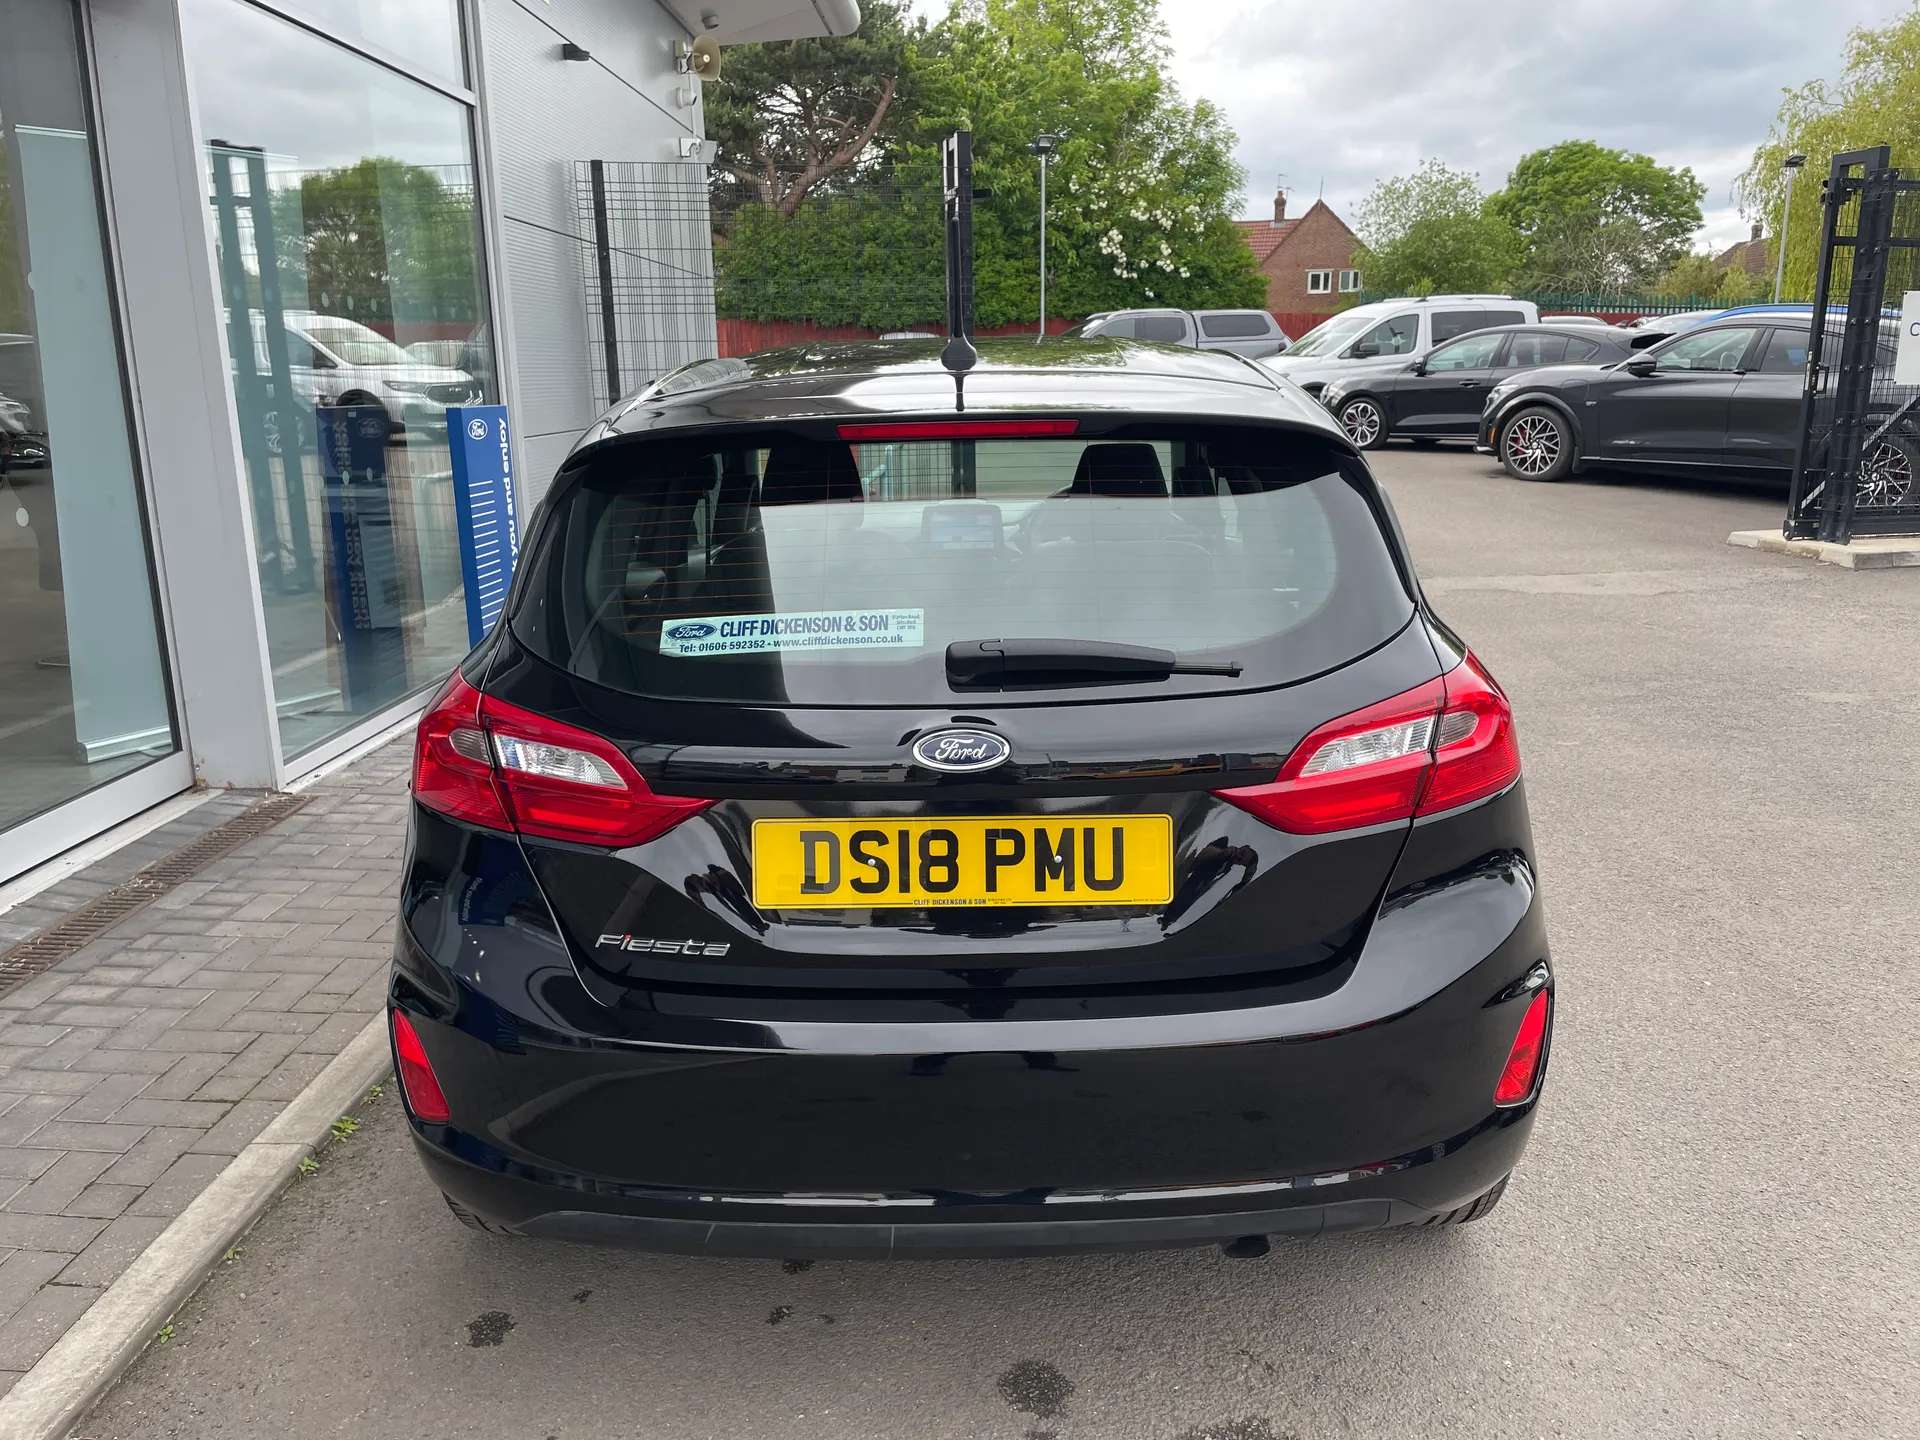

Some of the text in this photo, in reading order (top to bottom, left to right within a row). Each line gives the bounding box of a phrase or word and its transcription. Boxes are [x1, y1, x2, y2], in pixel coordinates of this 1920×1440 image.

[499, 416, 510, 474] enjoy
[503, 477, 513, 516] and
[508, 519, 519, 557] you
[674, 624, 707, 638] Ford
[720, 614, 889, 638] CLIFF DICKENSON & SON
[680, 634, 904, 653] Tel: 01606 592352 www.cliffdickenson.co.uk
[934, 738, 988, 760] Ford
[800, 826, 1125, 895] DS18 PMU
[595, 932, 731, 957] Fiesta
